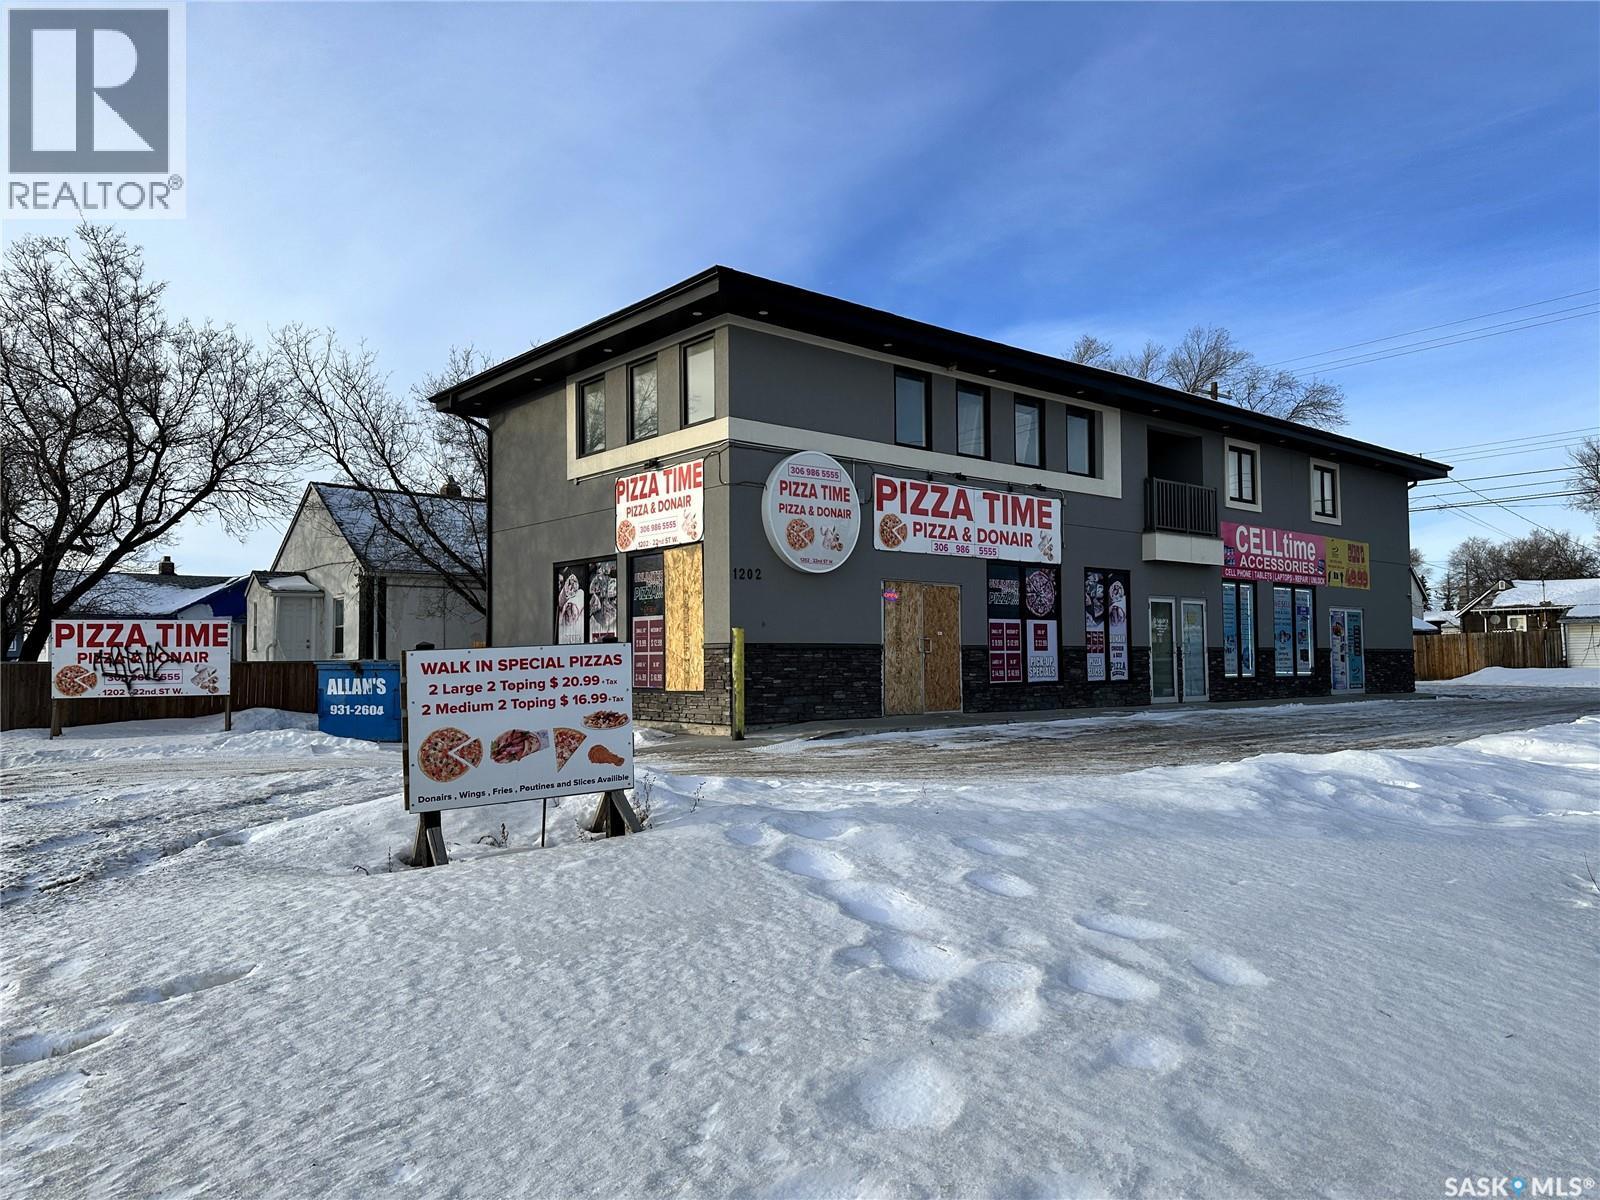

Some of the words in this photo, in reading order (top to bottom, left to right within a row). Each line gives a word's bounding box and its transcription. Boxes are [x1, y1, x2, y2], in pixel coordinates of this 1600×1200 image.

[616, 471, 659, 504] PIZZA
[662, 462, 703, 494] TIME
[790, 466, 805, 476] 306
[806, 467, 820, 478] 986
[822, 469, 839, 479] 5555
[779, 479, 818, 500] PIZZA
[820, 484, 850, 503] TIME
[626, 503, 649, 518] PIZZA
[650, 502, 656, 513] &
[657, 495, 691, 513] DONAIR
[778, 503, 806, 515] PIZZA
[808, 506, 815, 516] &
[816, 506, 852, 519] DONAIR
[875, 477, 974, 522] PIZZA
[982, 491, 1053, 530] TIME
[640, 525, 650, 534] 306
[651, 523, 662, 532] 986
[662, 520, 677, 530] 5555
[912, 521, 958, 541] PIZZA
[962, 527, 972, 543] &
[977, 527, 1033, 548] DONAIR
[934, 543, 949, 552] 306
[956, 544, 970, 554] 986
[978, 546, 997, 556] 5555
[1235, 525, 1316, 561] CELLtime
[733, 568, 762, 580] 1202
[1225, 568, 1236, 577] CELL
[1237, 569, 1252, 578] PHONE
[1239, 554, 1315, 575] ACCESSORIES
[55, 623, 147, 648] PIZZA
[156, 623, 228, 648] TIME
[77, 652, 126, 665] PIZZA
[146, 651, 209, 664] DONAIR
[420, 660, 471, 675] WALK
[475, 659, 493, 672] IN
[498, 656, 565, 671] SPECIAL
[569, 654, 623, 668] PIZZAS
[133, 688, 157, 696] 22nd
[172, 687, 184, 695] W.
[327, 678, 387, 695] ALLAN'S
[428, 684, 438, 695] 2
[442, 683, 483, 696] Large
[487, 681, 496, 692] 2
[500, 678, 545, 693] Toping
[550, 676, 558, 689] $
[562, 675, 600, 687] 20.99
[330, 704, 384, 715] 931-2604
[421, 704, 431, 715] 2
[435, 701, 493, 715] Medium
[498, 699, 507, 710] 2
[511, 697, 556, 710] Toping
[560, 694, 569, 707] $
[572, 693, 608, 705] 16.99
[418, 793, 452, 803] Donairs
[459, 790, 486, 799] Wings
[492, 786, 513, 795] Fries
[556, 780, 572, 788] and
[573, 778, 596, 786] Slices
